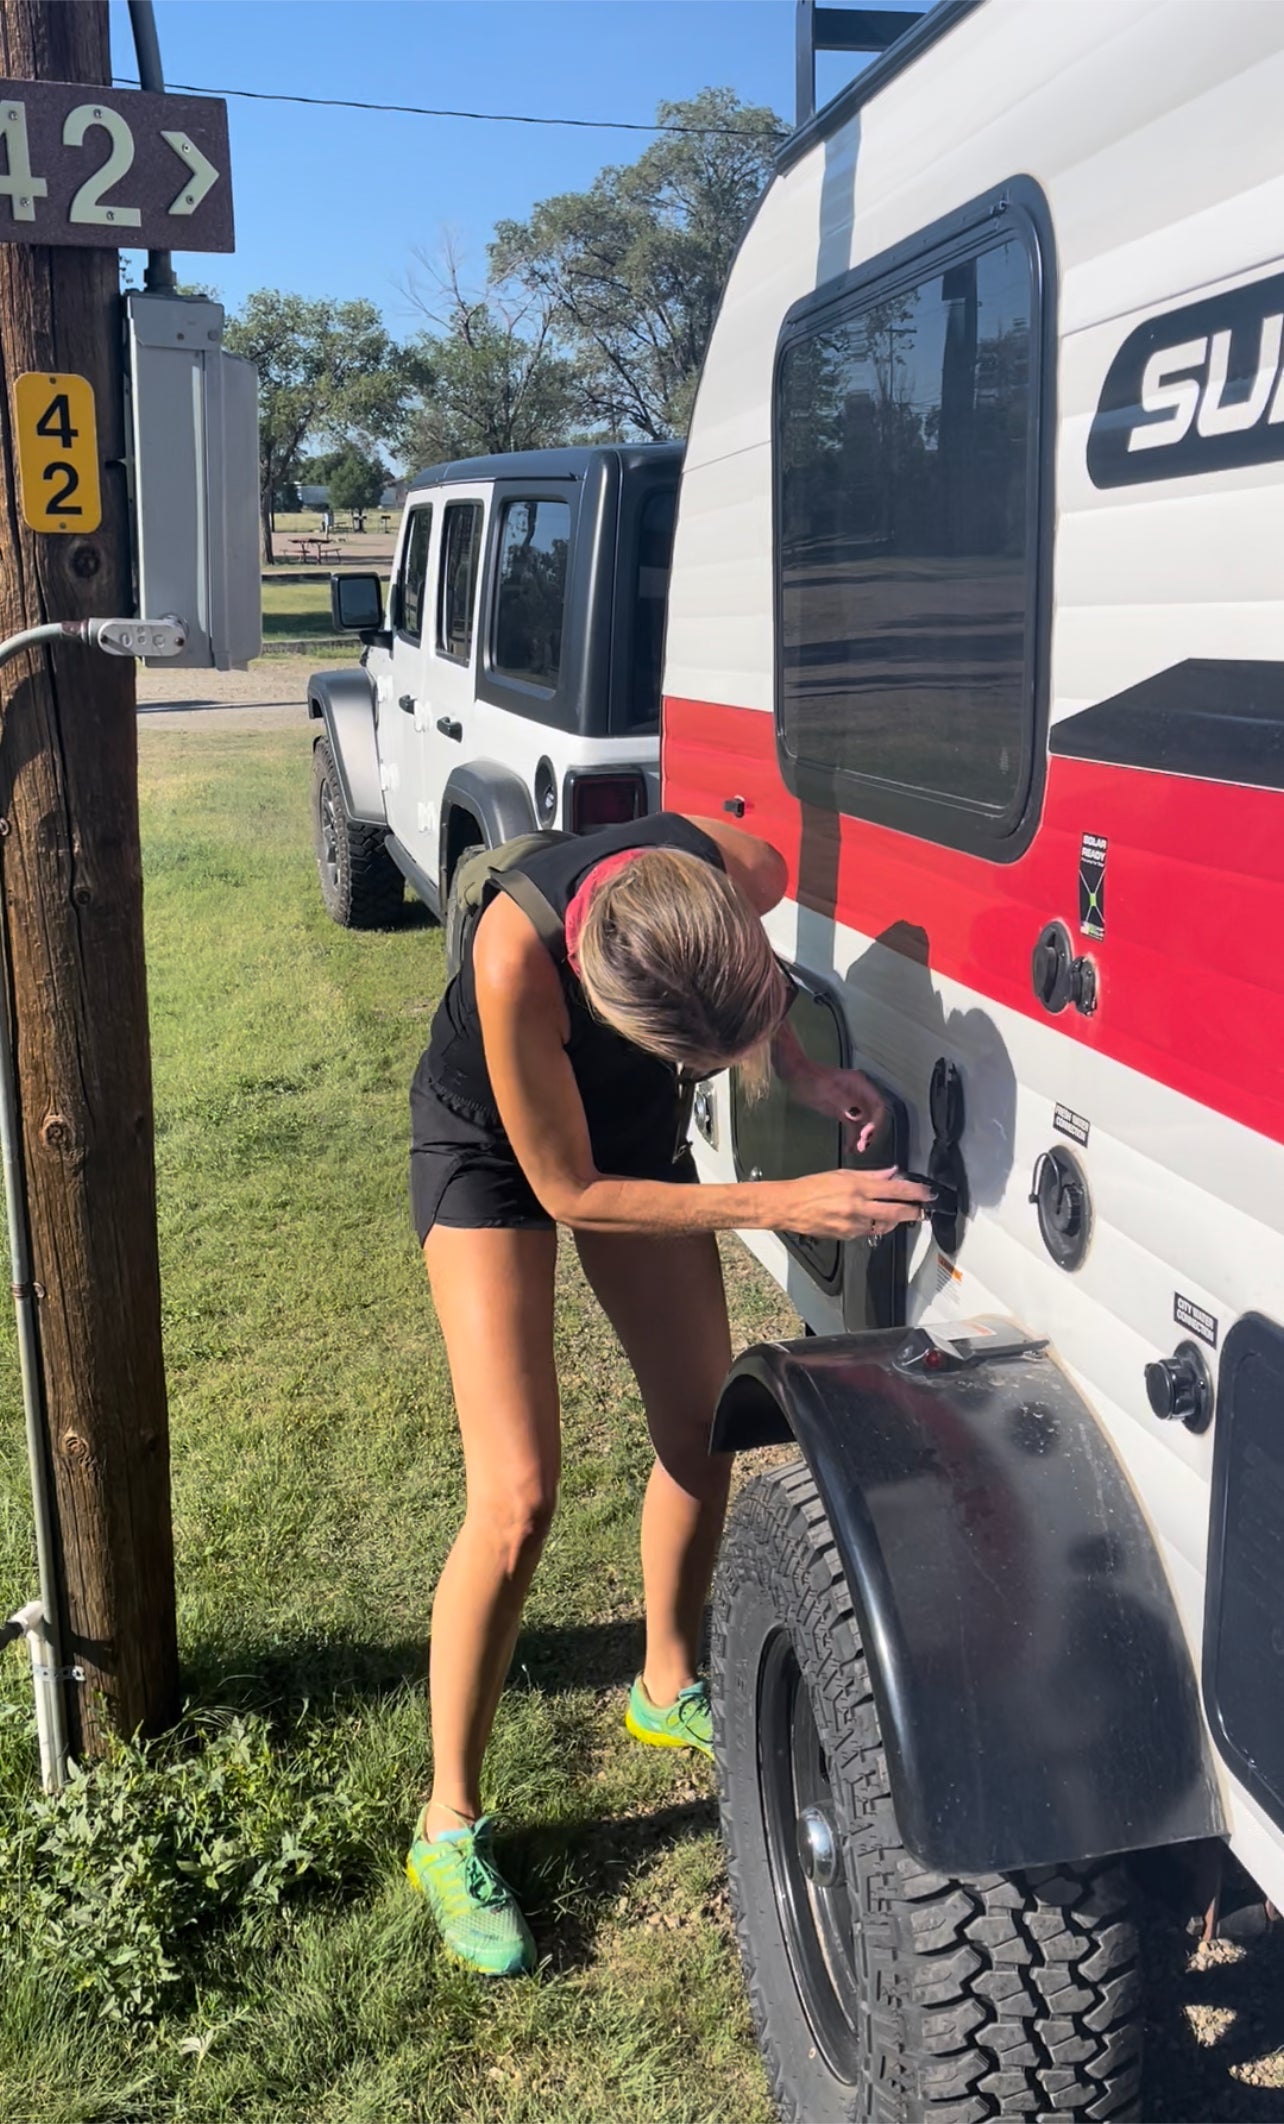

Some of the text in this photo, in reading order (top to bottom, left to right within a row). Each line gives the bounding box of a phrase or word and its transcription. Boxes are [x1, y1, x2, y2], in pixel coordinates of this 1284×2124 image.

[1127, 312, 1284, 453] SU
[1083, 835, 1107, 849] SOLAR
[1081, 847, 1106, 862] READY
[1177, 1297, 1192, 1314] CITY
